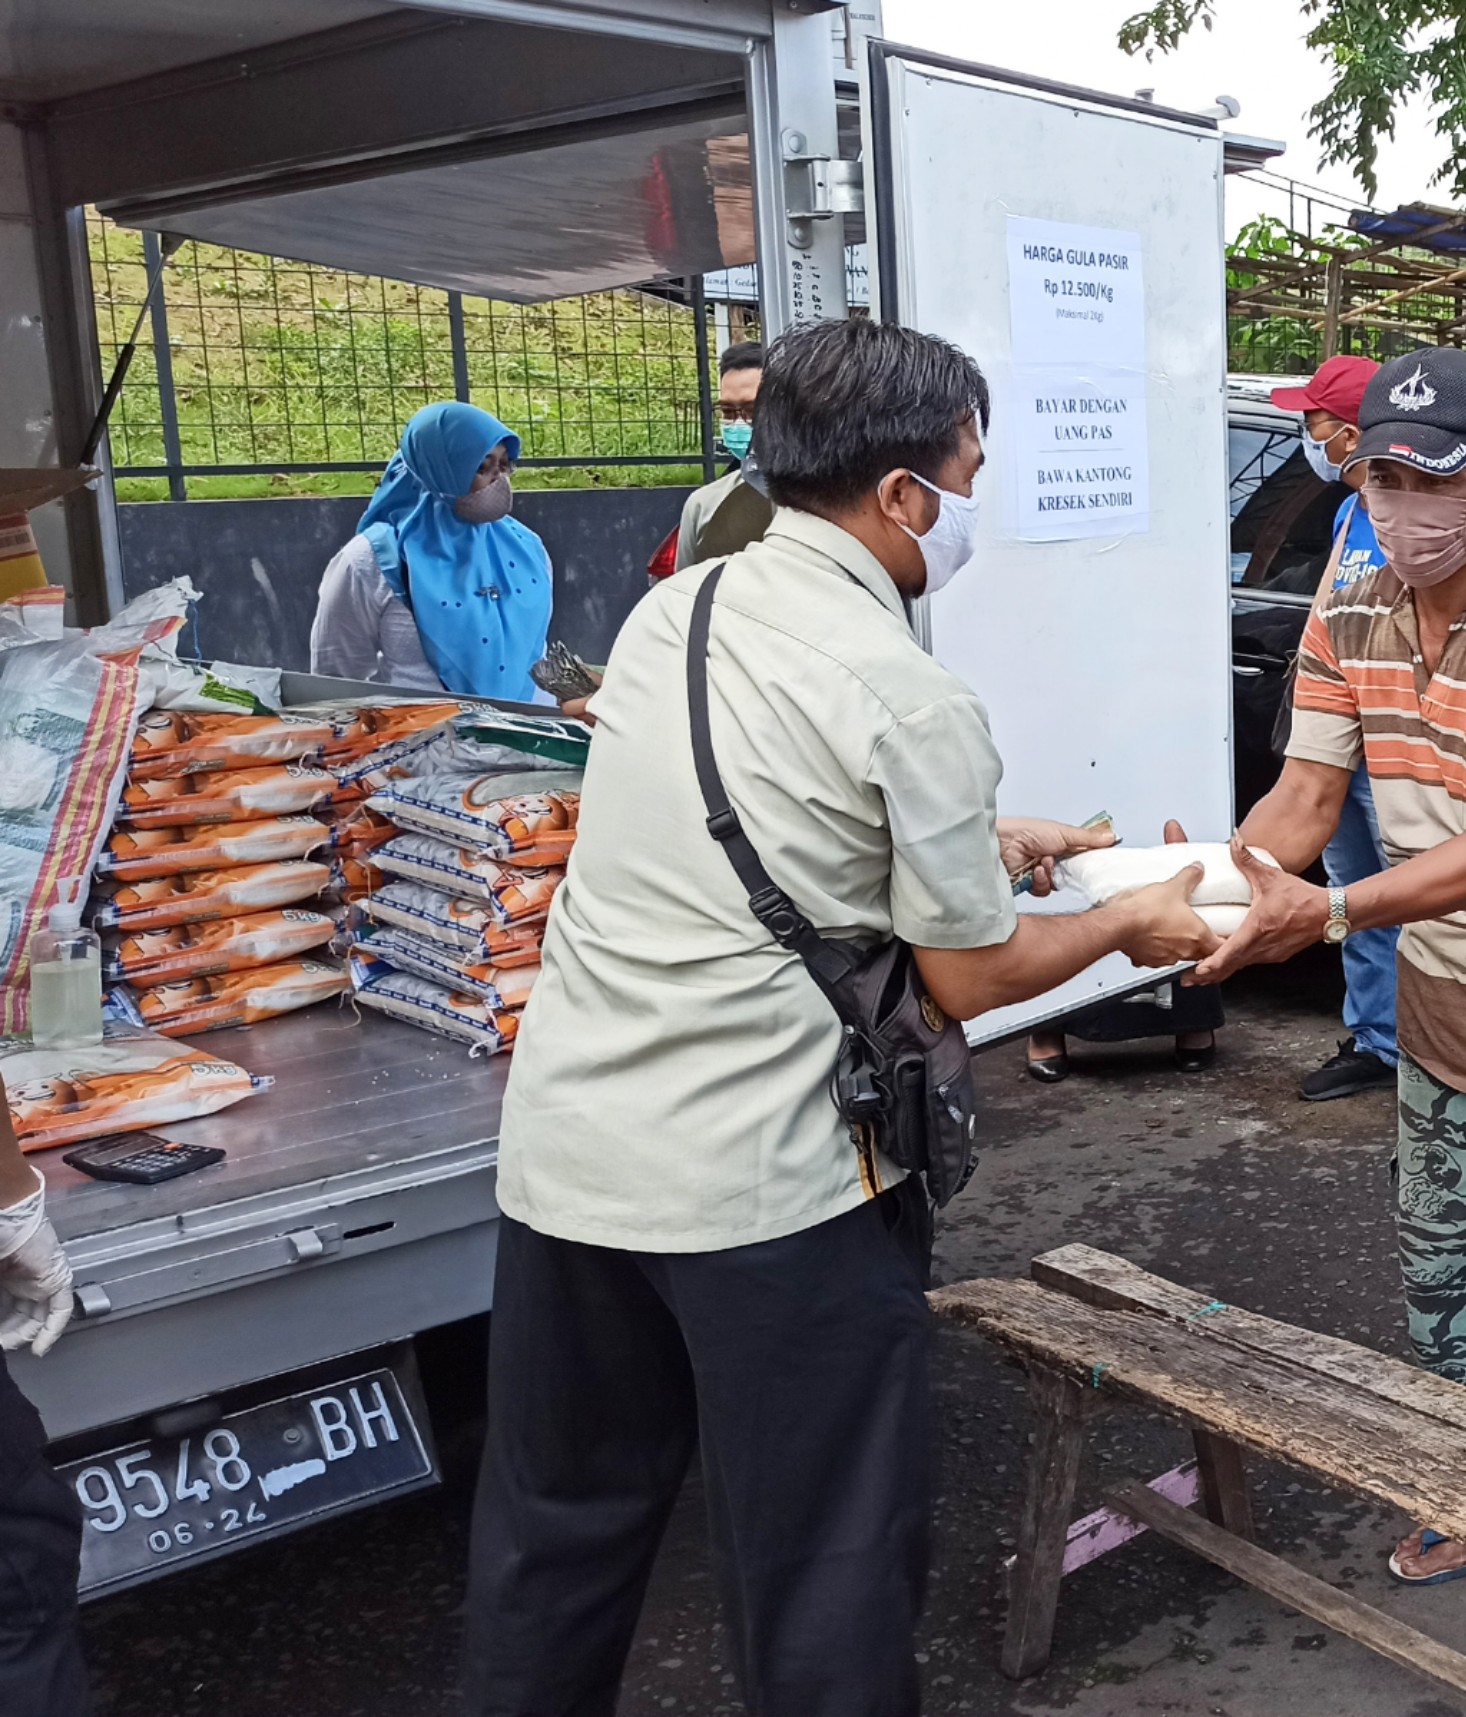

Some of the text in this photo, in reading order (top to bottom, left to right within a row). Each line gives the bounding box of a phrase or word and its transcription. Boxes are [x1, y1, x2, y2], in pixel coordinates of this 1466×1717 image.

[1023, 243, 1129, 270] HARGA GULA PASIR
[1044, 279, 1113, 303] Rp 12.500/Kg
[1056, 307, 1089, 320] (Maksimal
[1035, 398, 1127, 413] BAYAR DENGAN
[1054, 424, 1112, 440] UANG PAS
[1037, 465, 1132, 485] BAWA KANTONG
[1038, 491, 1132, 512] KRESEK SENDIRI
[75, 1381, 400, 1532] 9548 BH
